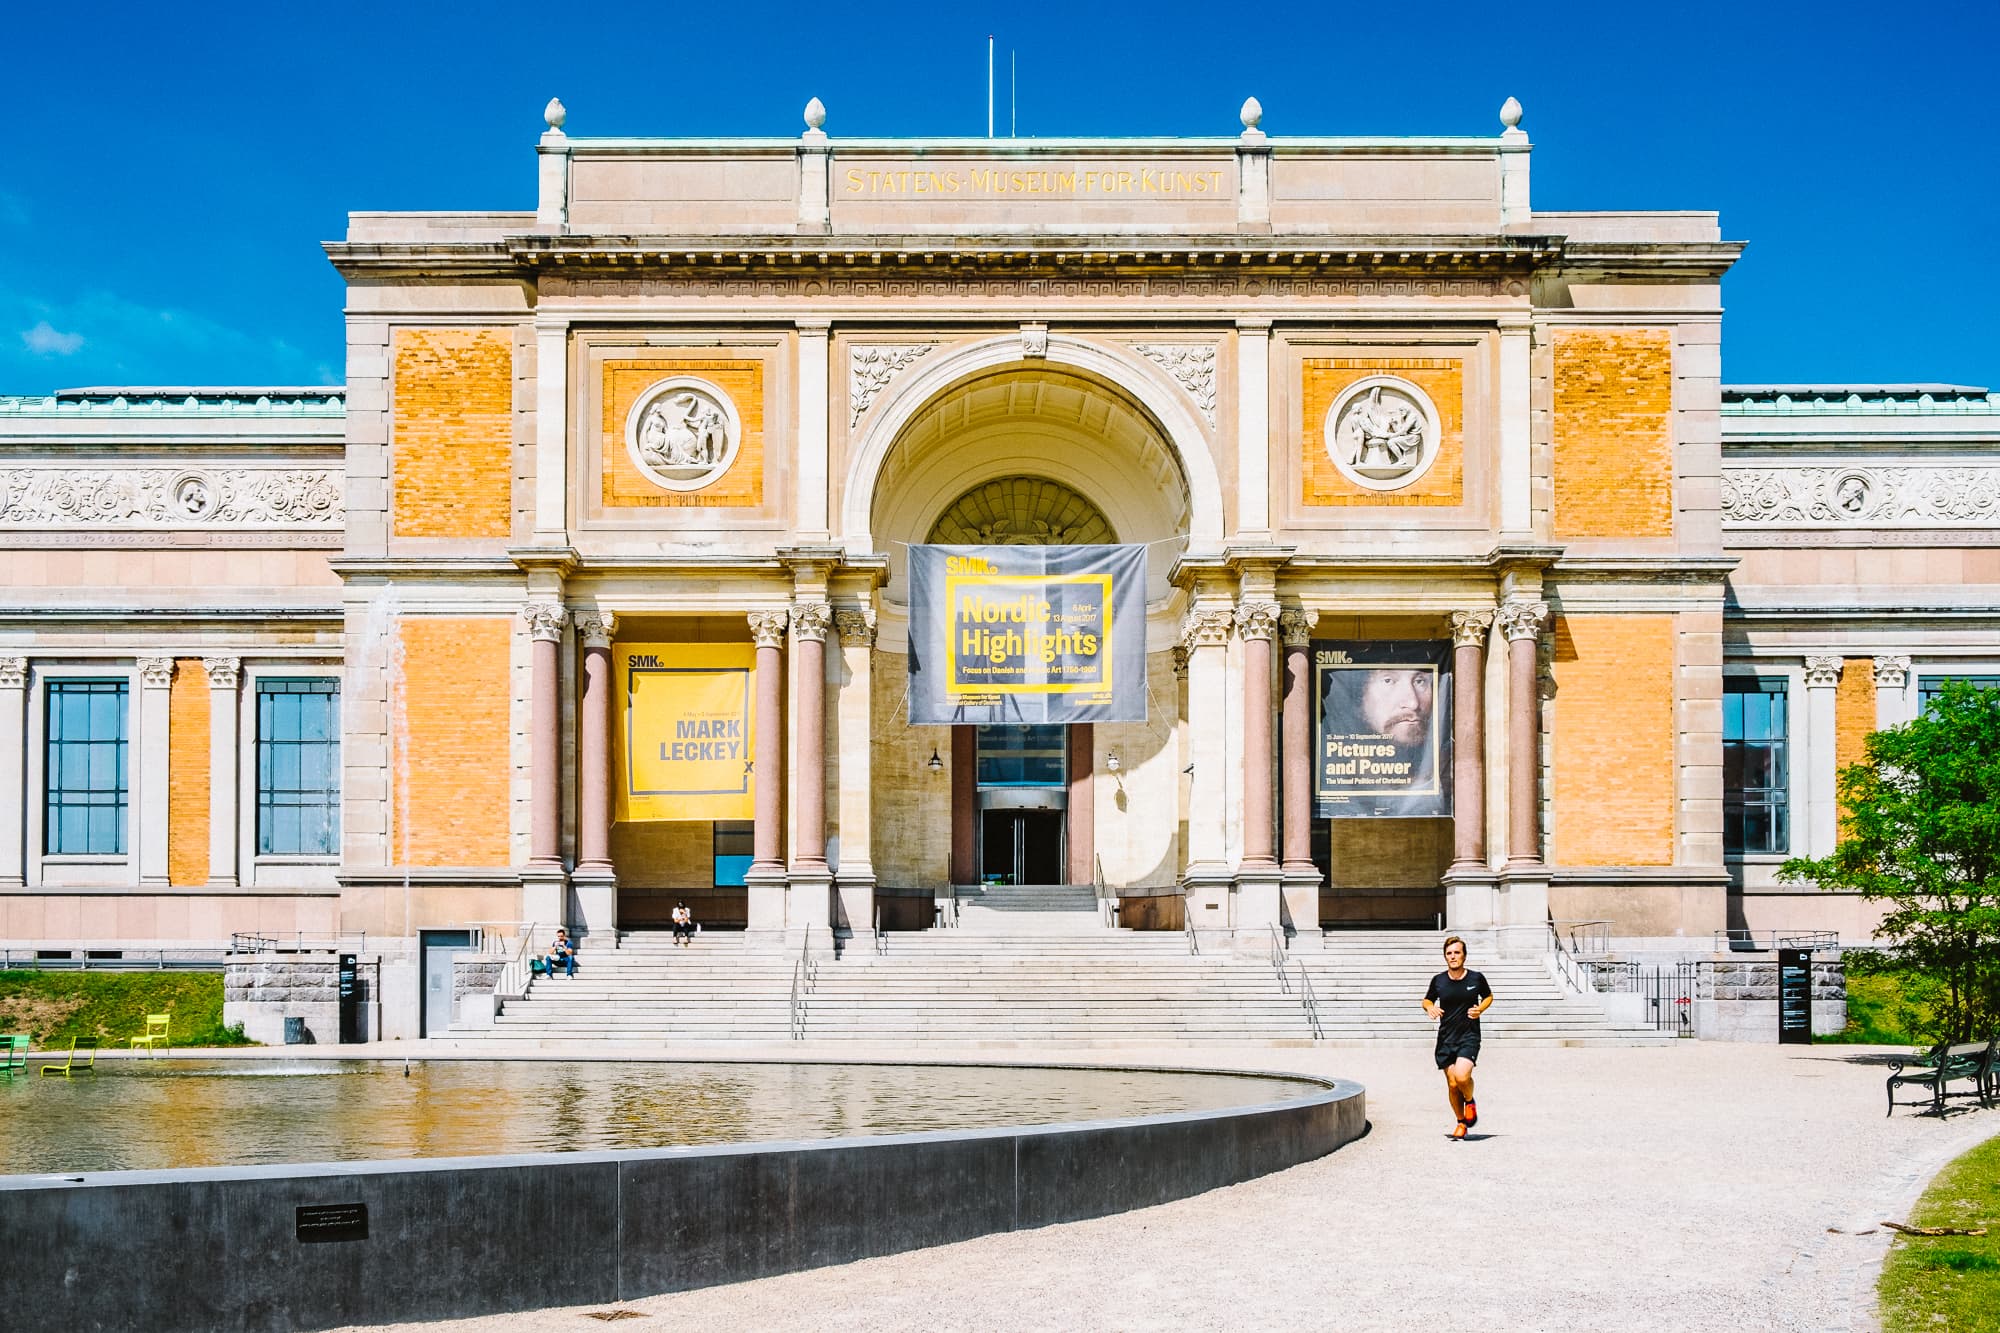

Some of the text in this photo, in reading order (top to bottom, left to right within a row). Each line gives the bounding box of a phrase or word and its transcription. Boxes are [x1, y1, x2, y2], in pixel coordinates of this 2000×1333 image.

[962, 595, 1051, 624] Nordic
[962, 629, 1097, 663] Highlights
[962, 666, 981, 674] Focus
[992, 666, 1014, 674] Danish
[1051, 666, 1062, 674] Art
[676, 719, 741, 739] MARK
[660, 741, 740, 761] LECKEY
[1326, 741, 1396, 758] Pictures
[1326, 760, 1412, 775] and Power
